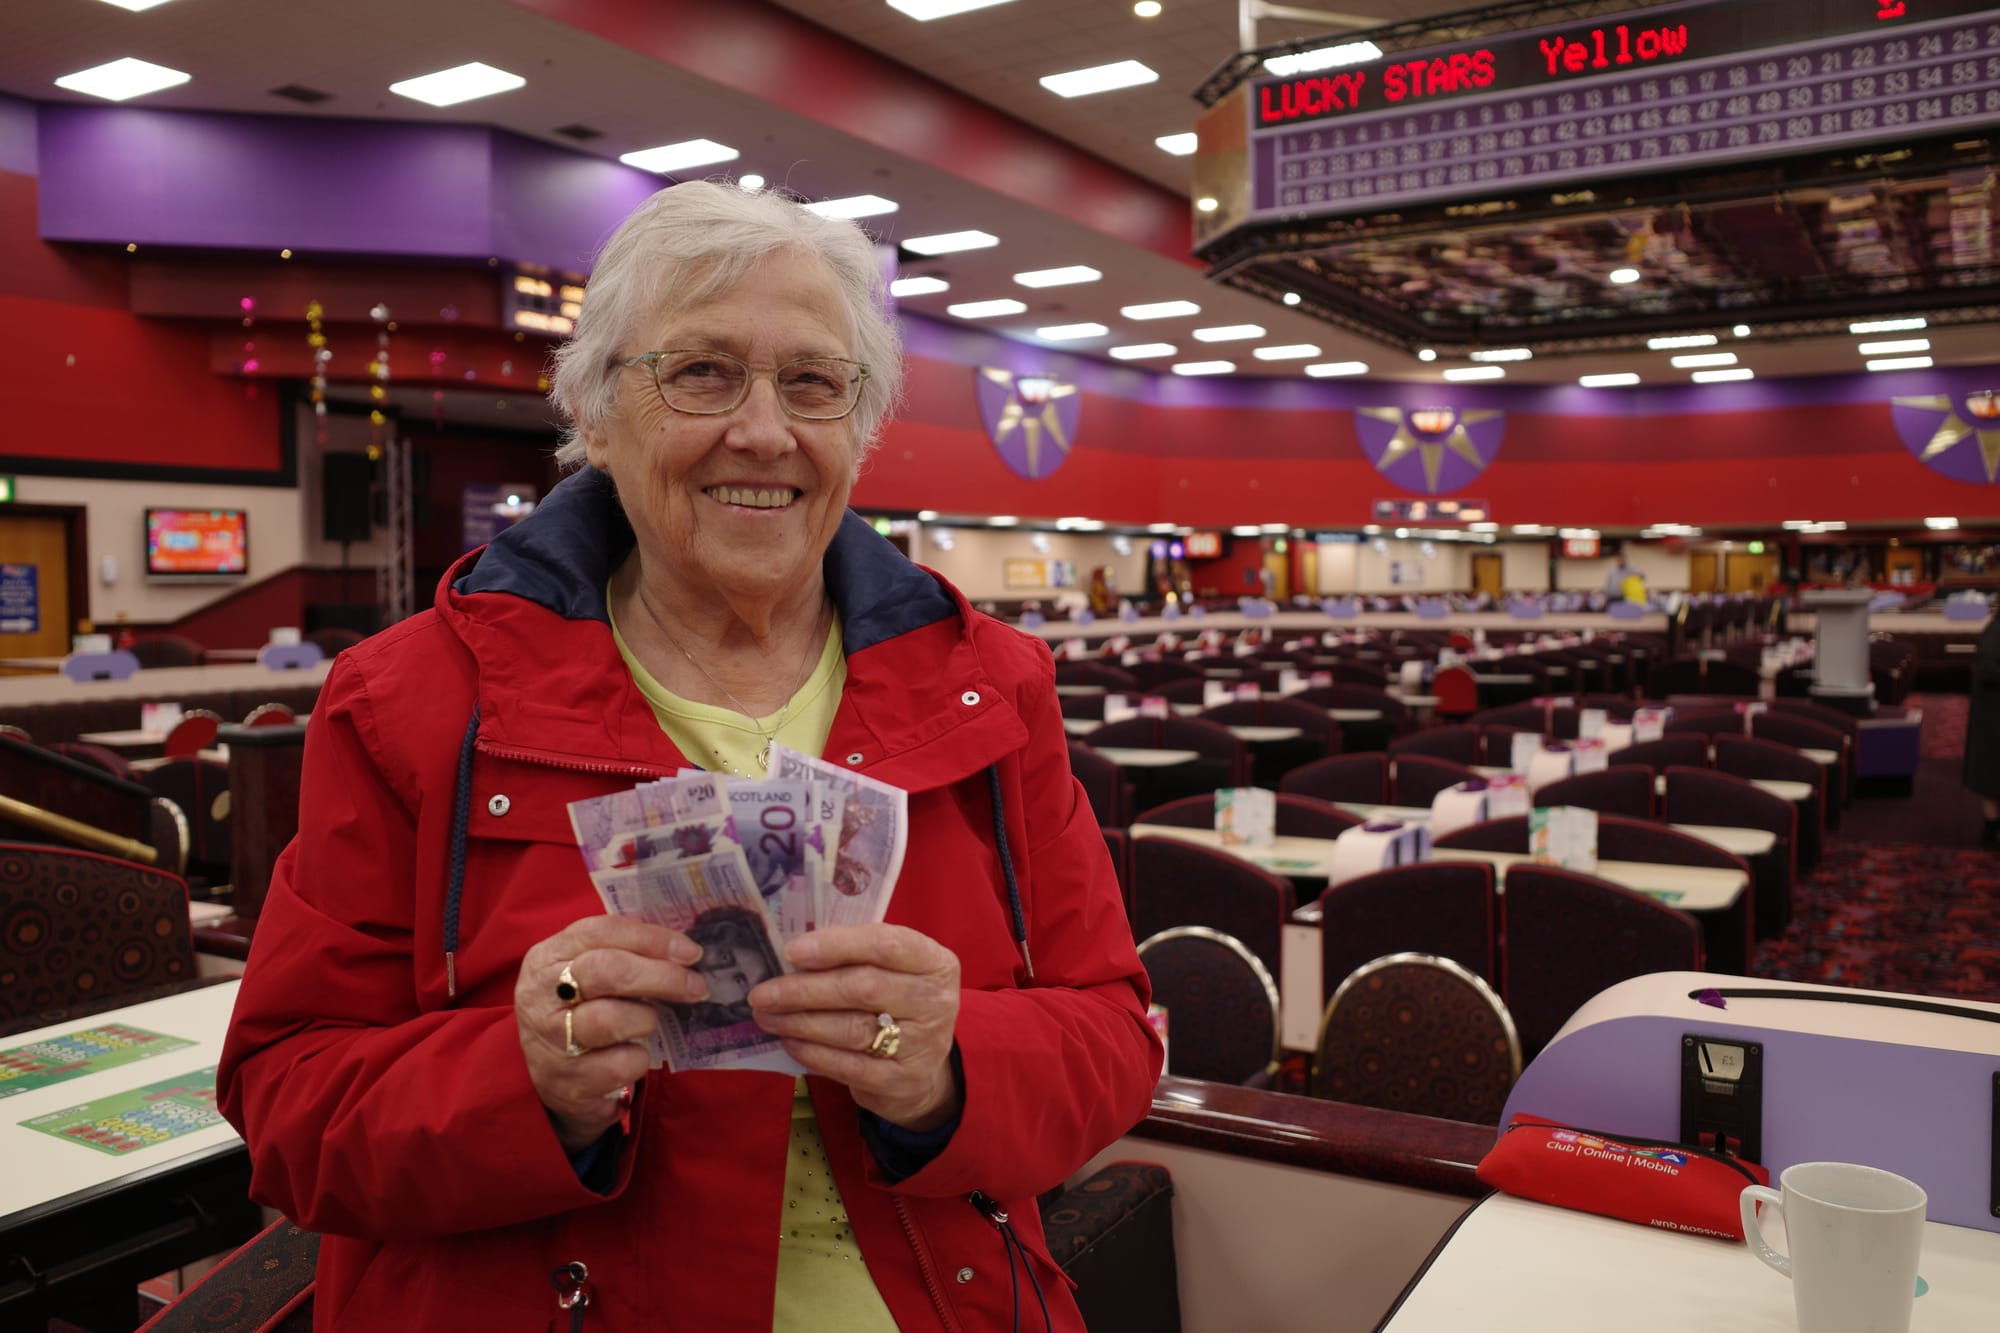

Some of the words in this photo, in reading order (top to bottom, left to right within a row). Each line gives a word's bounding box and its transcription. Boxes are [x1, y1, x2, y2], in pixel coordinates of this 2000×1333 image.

[1261, 71, 1365, 122] LUCKY
[1384, 49, 1495, 101] STARS
[1539, 24, 1688, 75] Yellow
[1729, 67, 1747, 86] 18
[1760, 62, 1778, 81] 19
[1787, 57, 1811, 77] 20
[1822, 52, 1841, 72] 21
[1852, 47, 1875, 68] 22
[1885, 41, 1909, 62] 23
[1918, 35, 1943, 56] 24
[1952, 30, 1977, 50] 25
[1726, 96, 1751, 115] 48
[1757, 92, 1781, 111] 49
[1787, 87, 1812, 107] 50
[1822, 82, 1841, 103] 51
[1852, 77, 1875, 98] 52
[1884, 72, 1909, 93] 53
[1918, 67, 1943, 88] 54
[1952, 61, 1978, 83] 55
[1728, 126, 1750, 145] 78
[1759, 121, 1780, 142] 79
[1787, 117, 1812, 138] 80
[1821, 113, 1841, 133] 81
[1851, 107, 1875, 129] 82
[1884, 103, 1909, 124] 83
[1916, 98, 1943, 119] 84
[1951, 93, 1978, 114] 85
[760, 805, 796, 856] 20
[1546, 1141, 1575, 1153] Club
[1583, 1147, 1625, 1163] Online
[1634, 1157, 1679, 1175] Mobile
